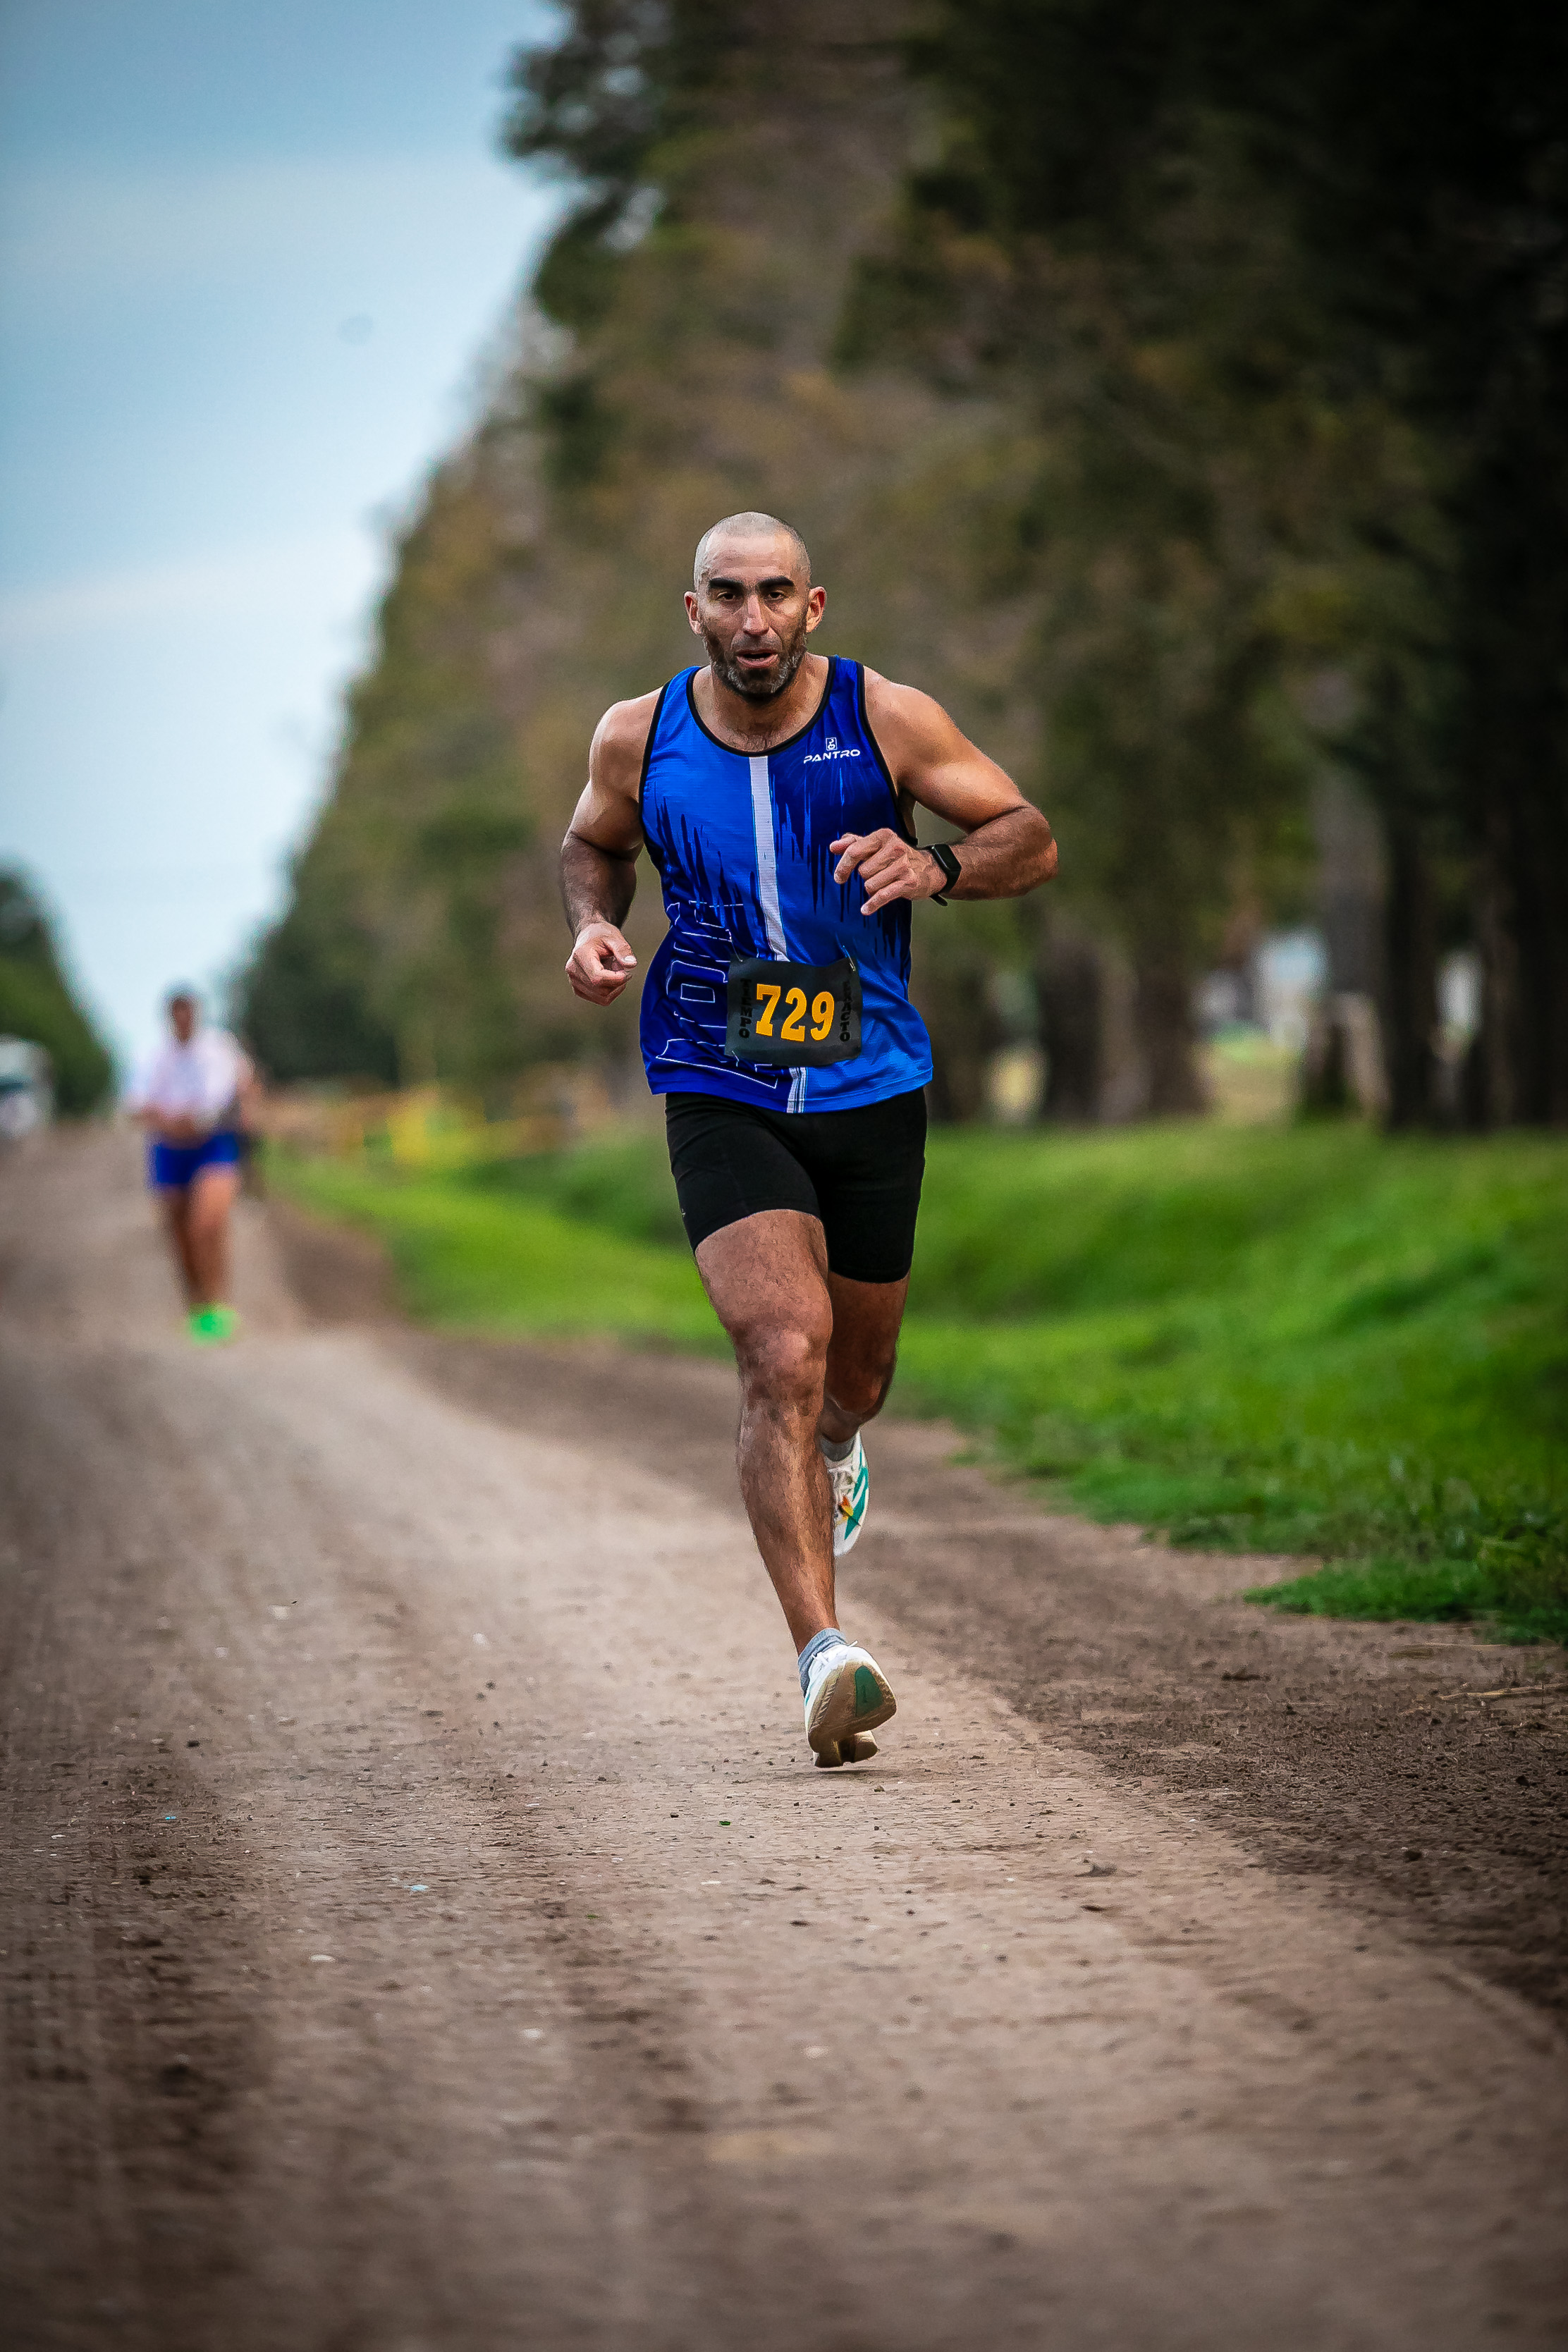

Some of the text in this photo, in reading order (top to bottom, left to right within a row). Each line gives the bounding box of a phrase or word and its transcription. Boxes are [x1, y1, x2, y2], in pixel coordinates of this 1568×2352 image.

[803, 749, 861, 764] PANTRO
[739, 979, 752, 1039] TIEMPO
[755, 984, 835, 1042] 729
